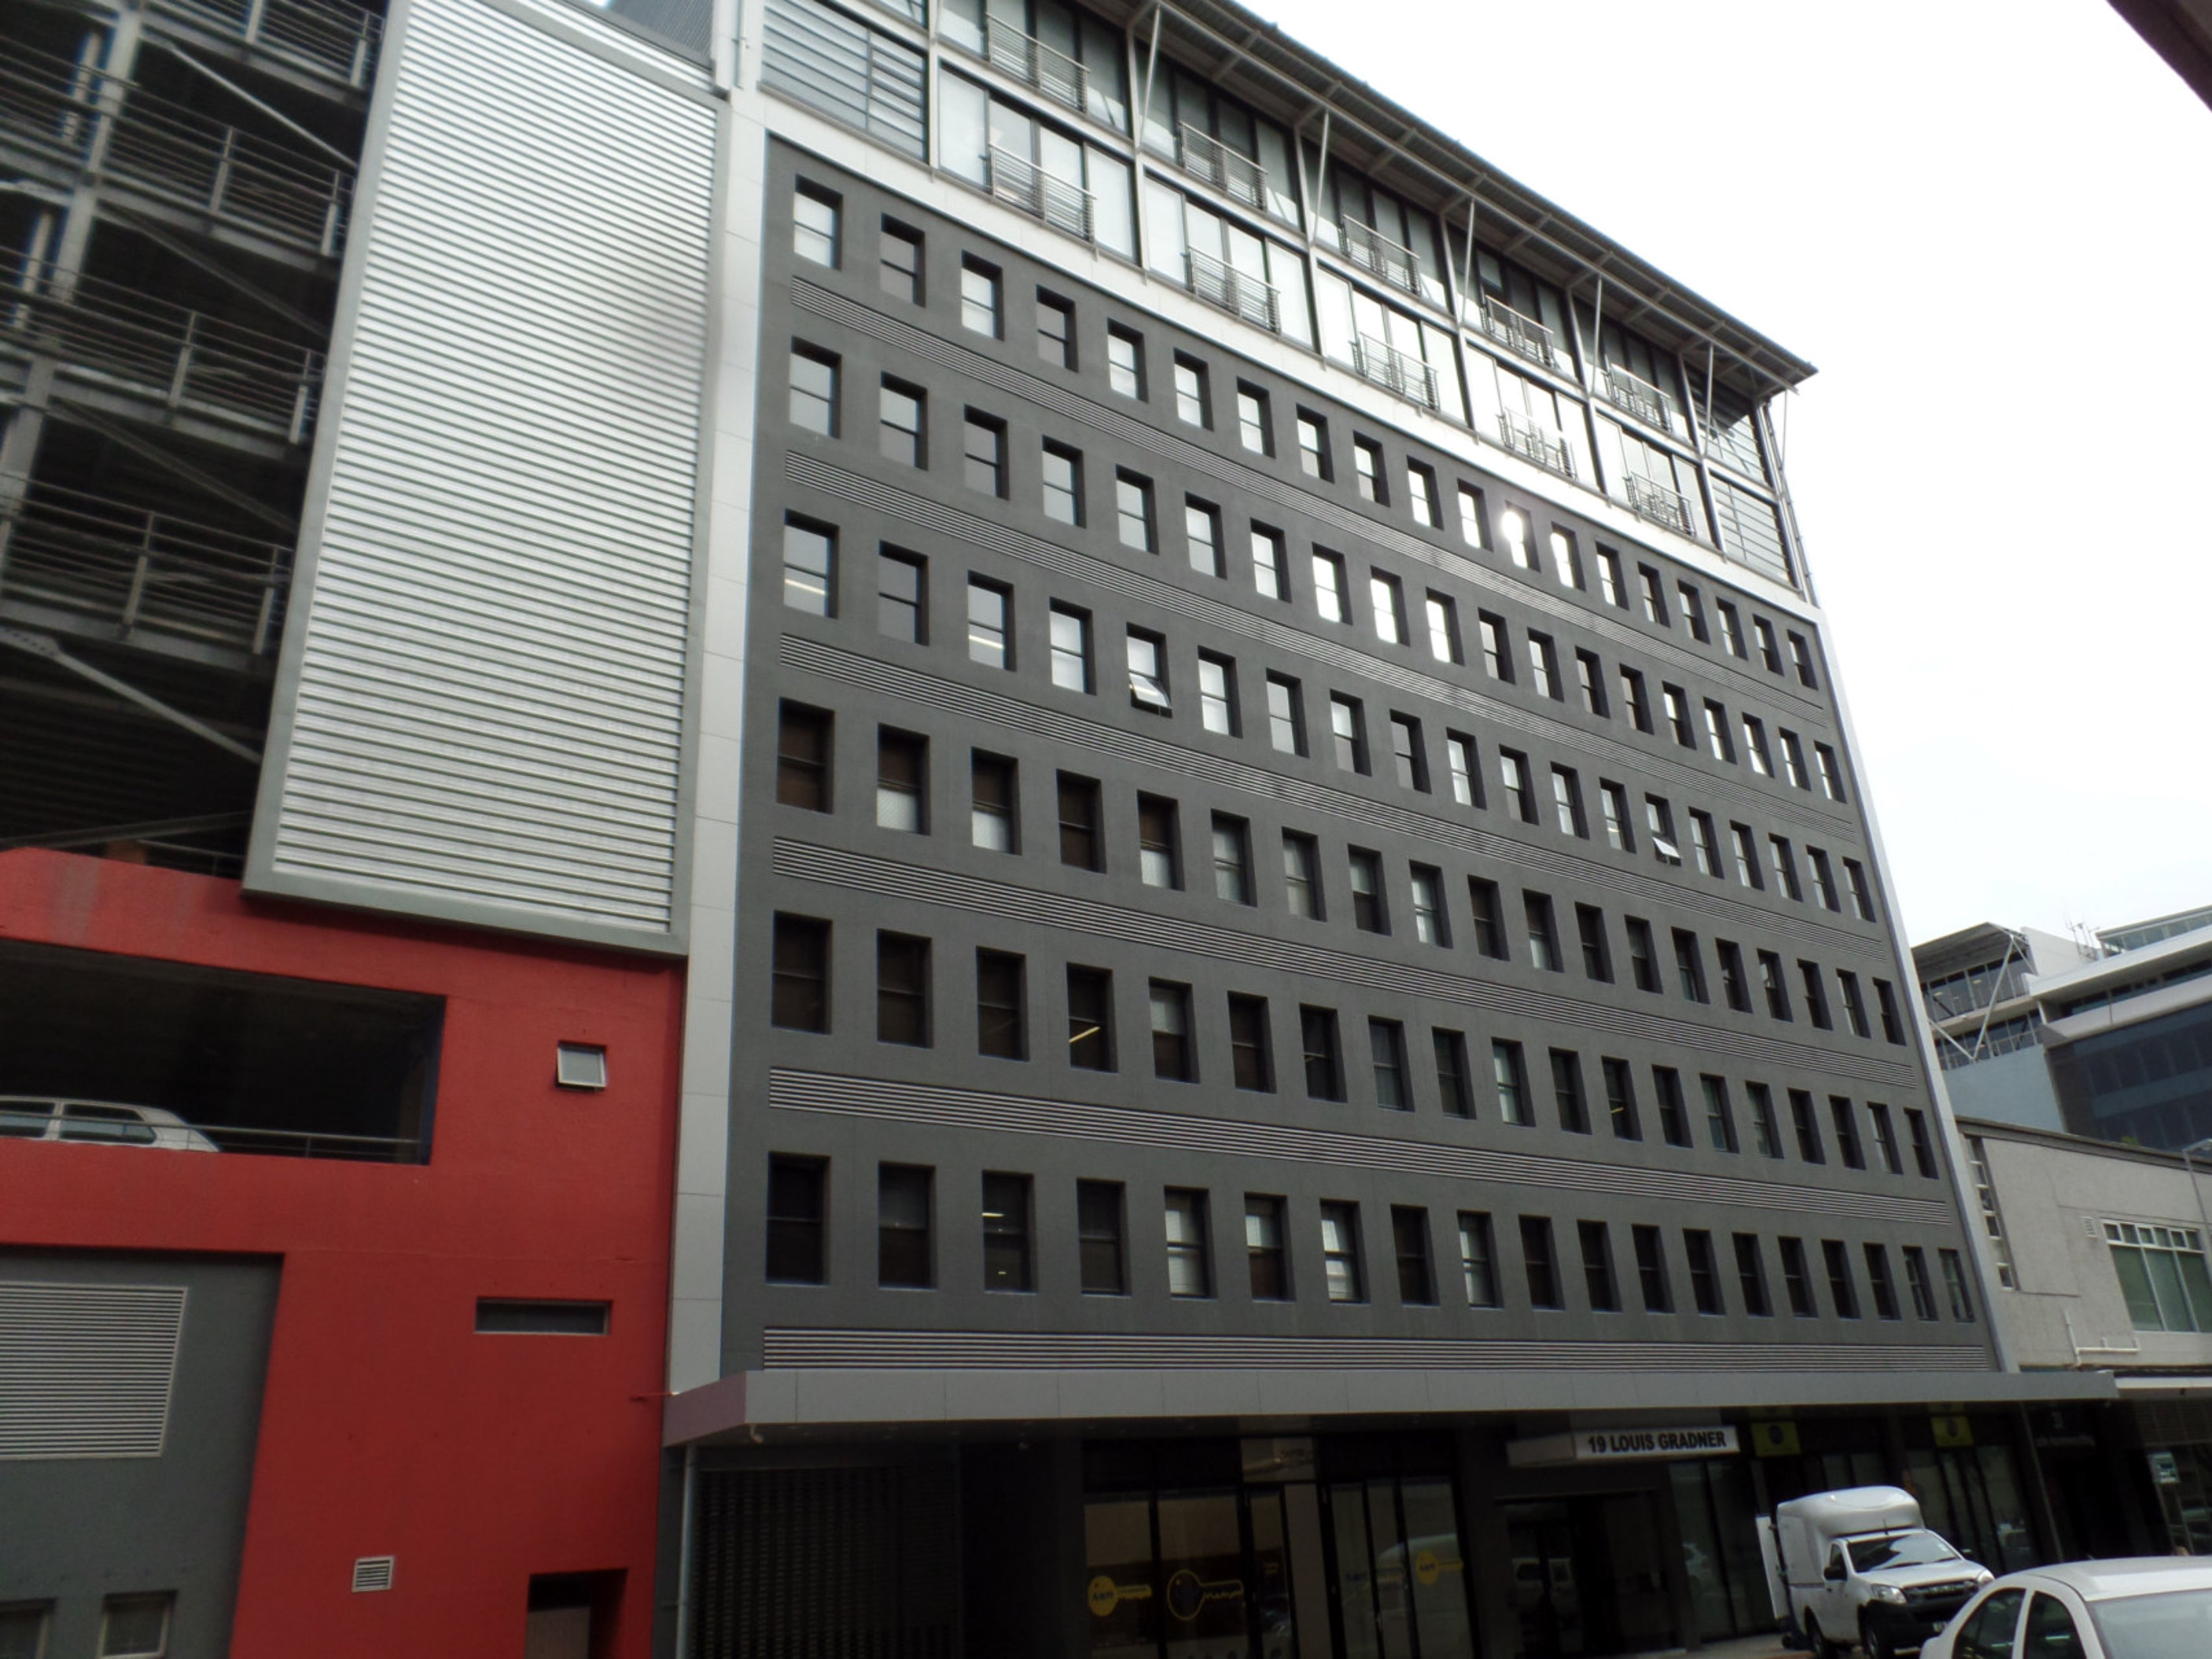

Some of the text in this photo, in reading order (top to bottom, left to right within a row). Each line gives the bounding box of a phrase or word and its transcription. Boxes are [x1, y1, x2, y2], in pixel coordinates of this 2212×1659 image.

[1588, 1431, 1726, 1453] 19 LOUIS GRADNER
